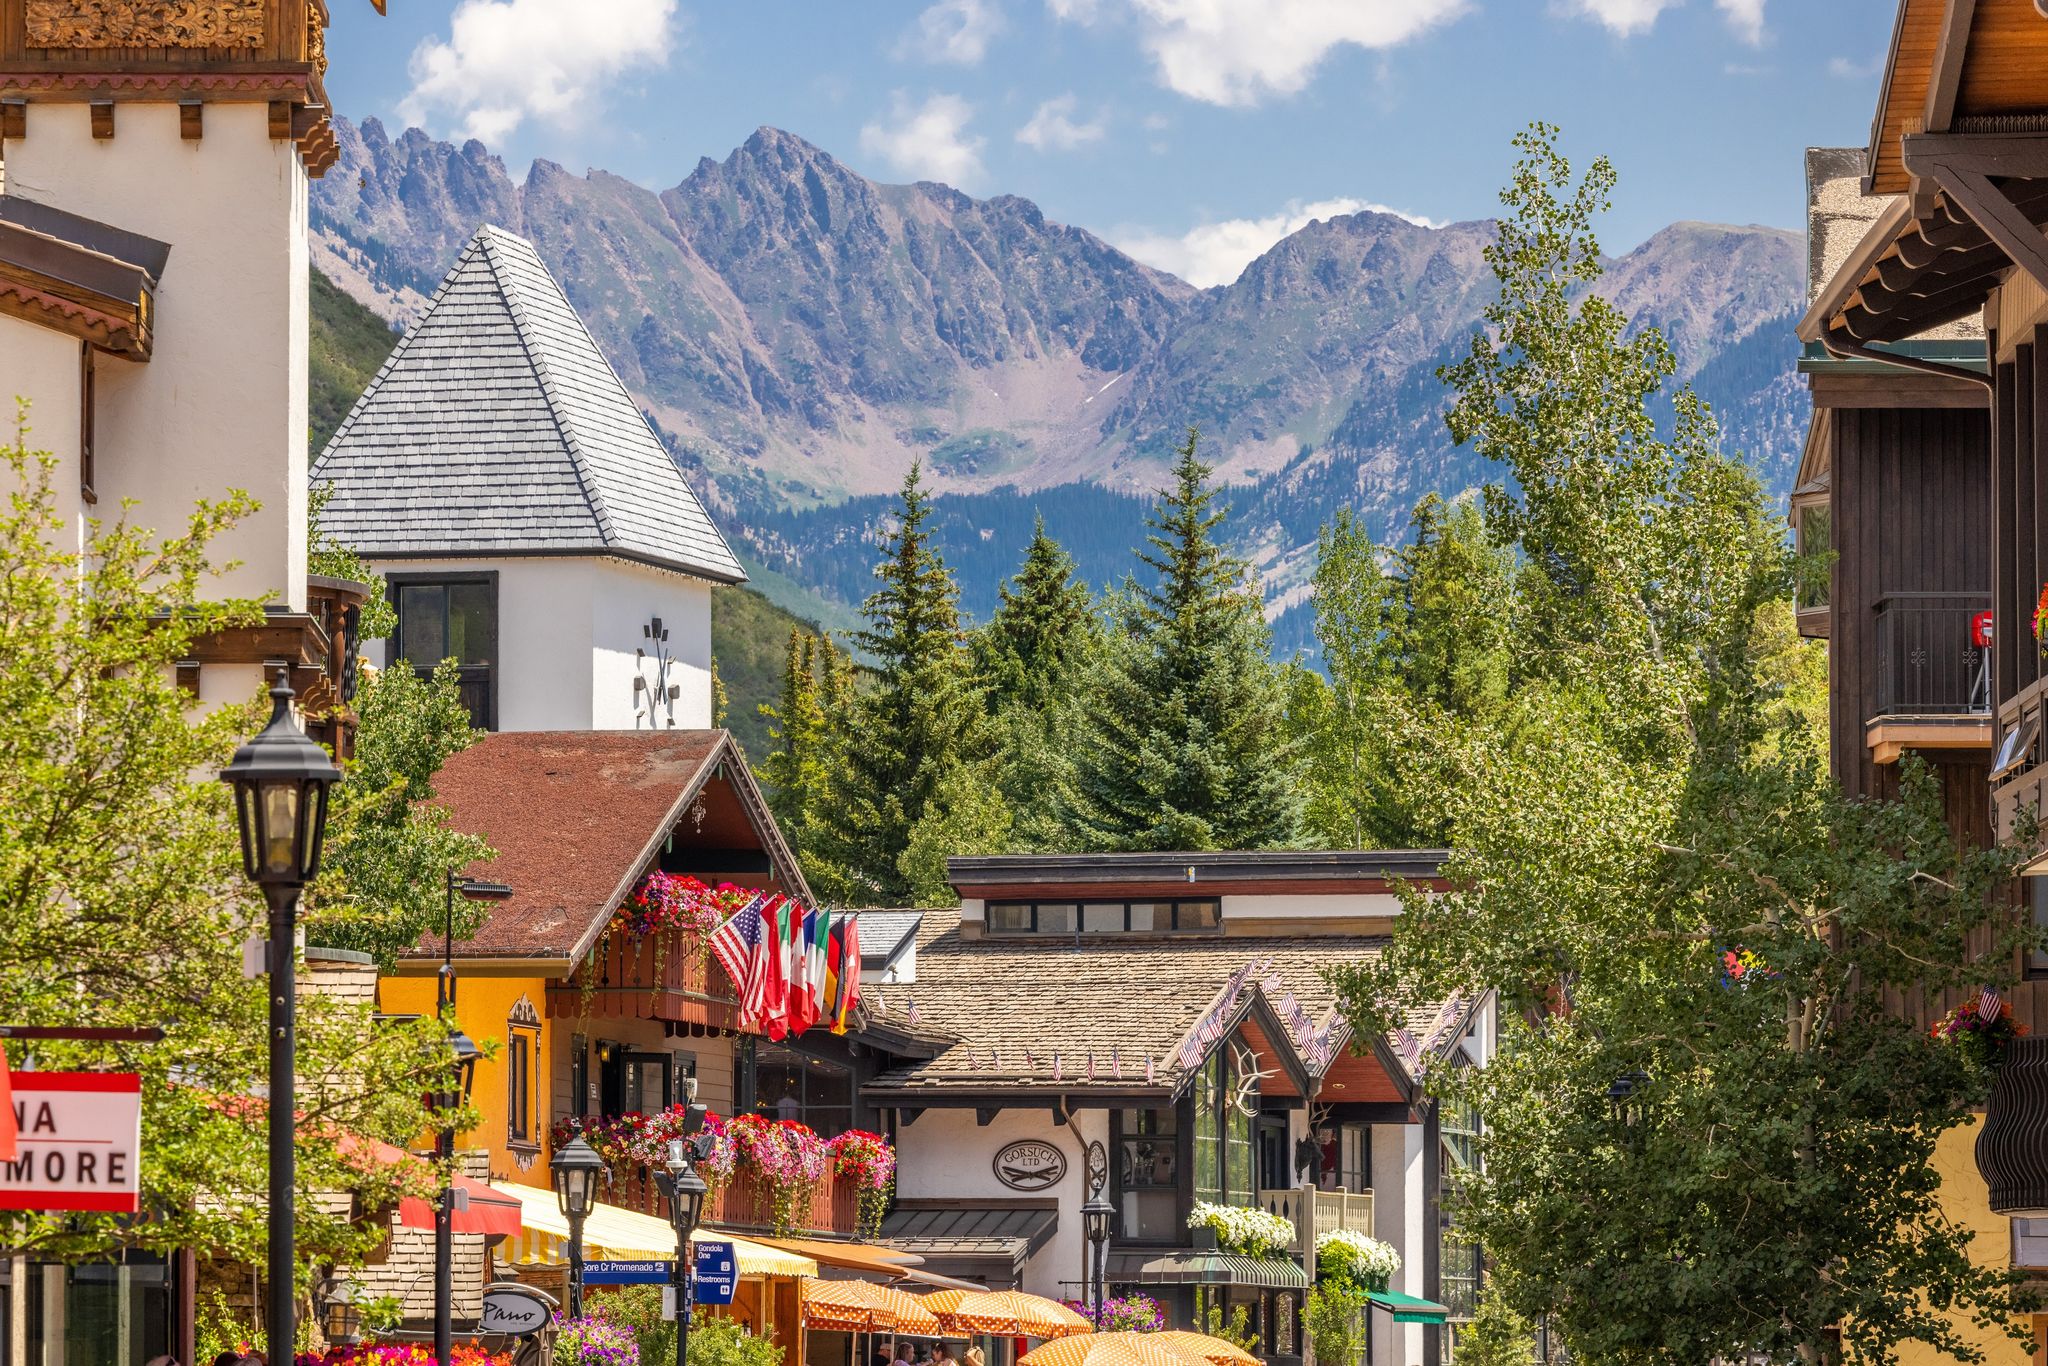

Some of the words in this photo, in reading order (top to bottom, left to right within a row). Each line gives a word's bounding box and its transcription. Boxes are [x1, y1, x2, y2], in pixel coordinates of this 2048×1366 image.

[1004, 1147, 1057, 1165] GORSUCH
[5, 1150, 126, 1184] MORE
[1022, 1158, 1040, 1166] LTD
[698, 1244, 723, 1252] Gondola
[698, 1252, 711, 1260] One
[600, 1262, 610, 1272] Cr
[611, 1262, 653, 1272] Promenade
[483, 1301, 536, 1322] Pano
